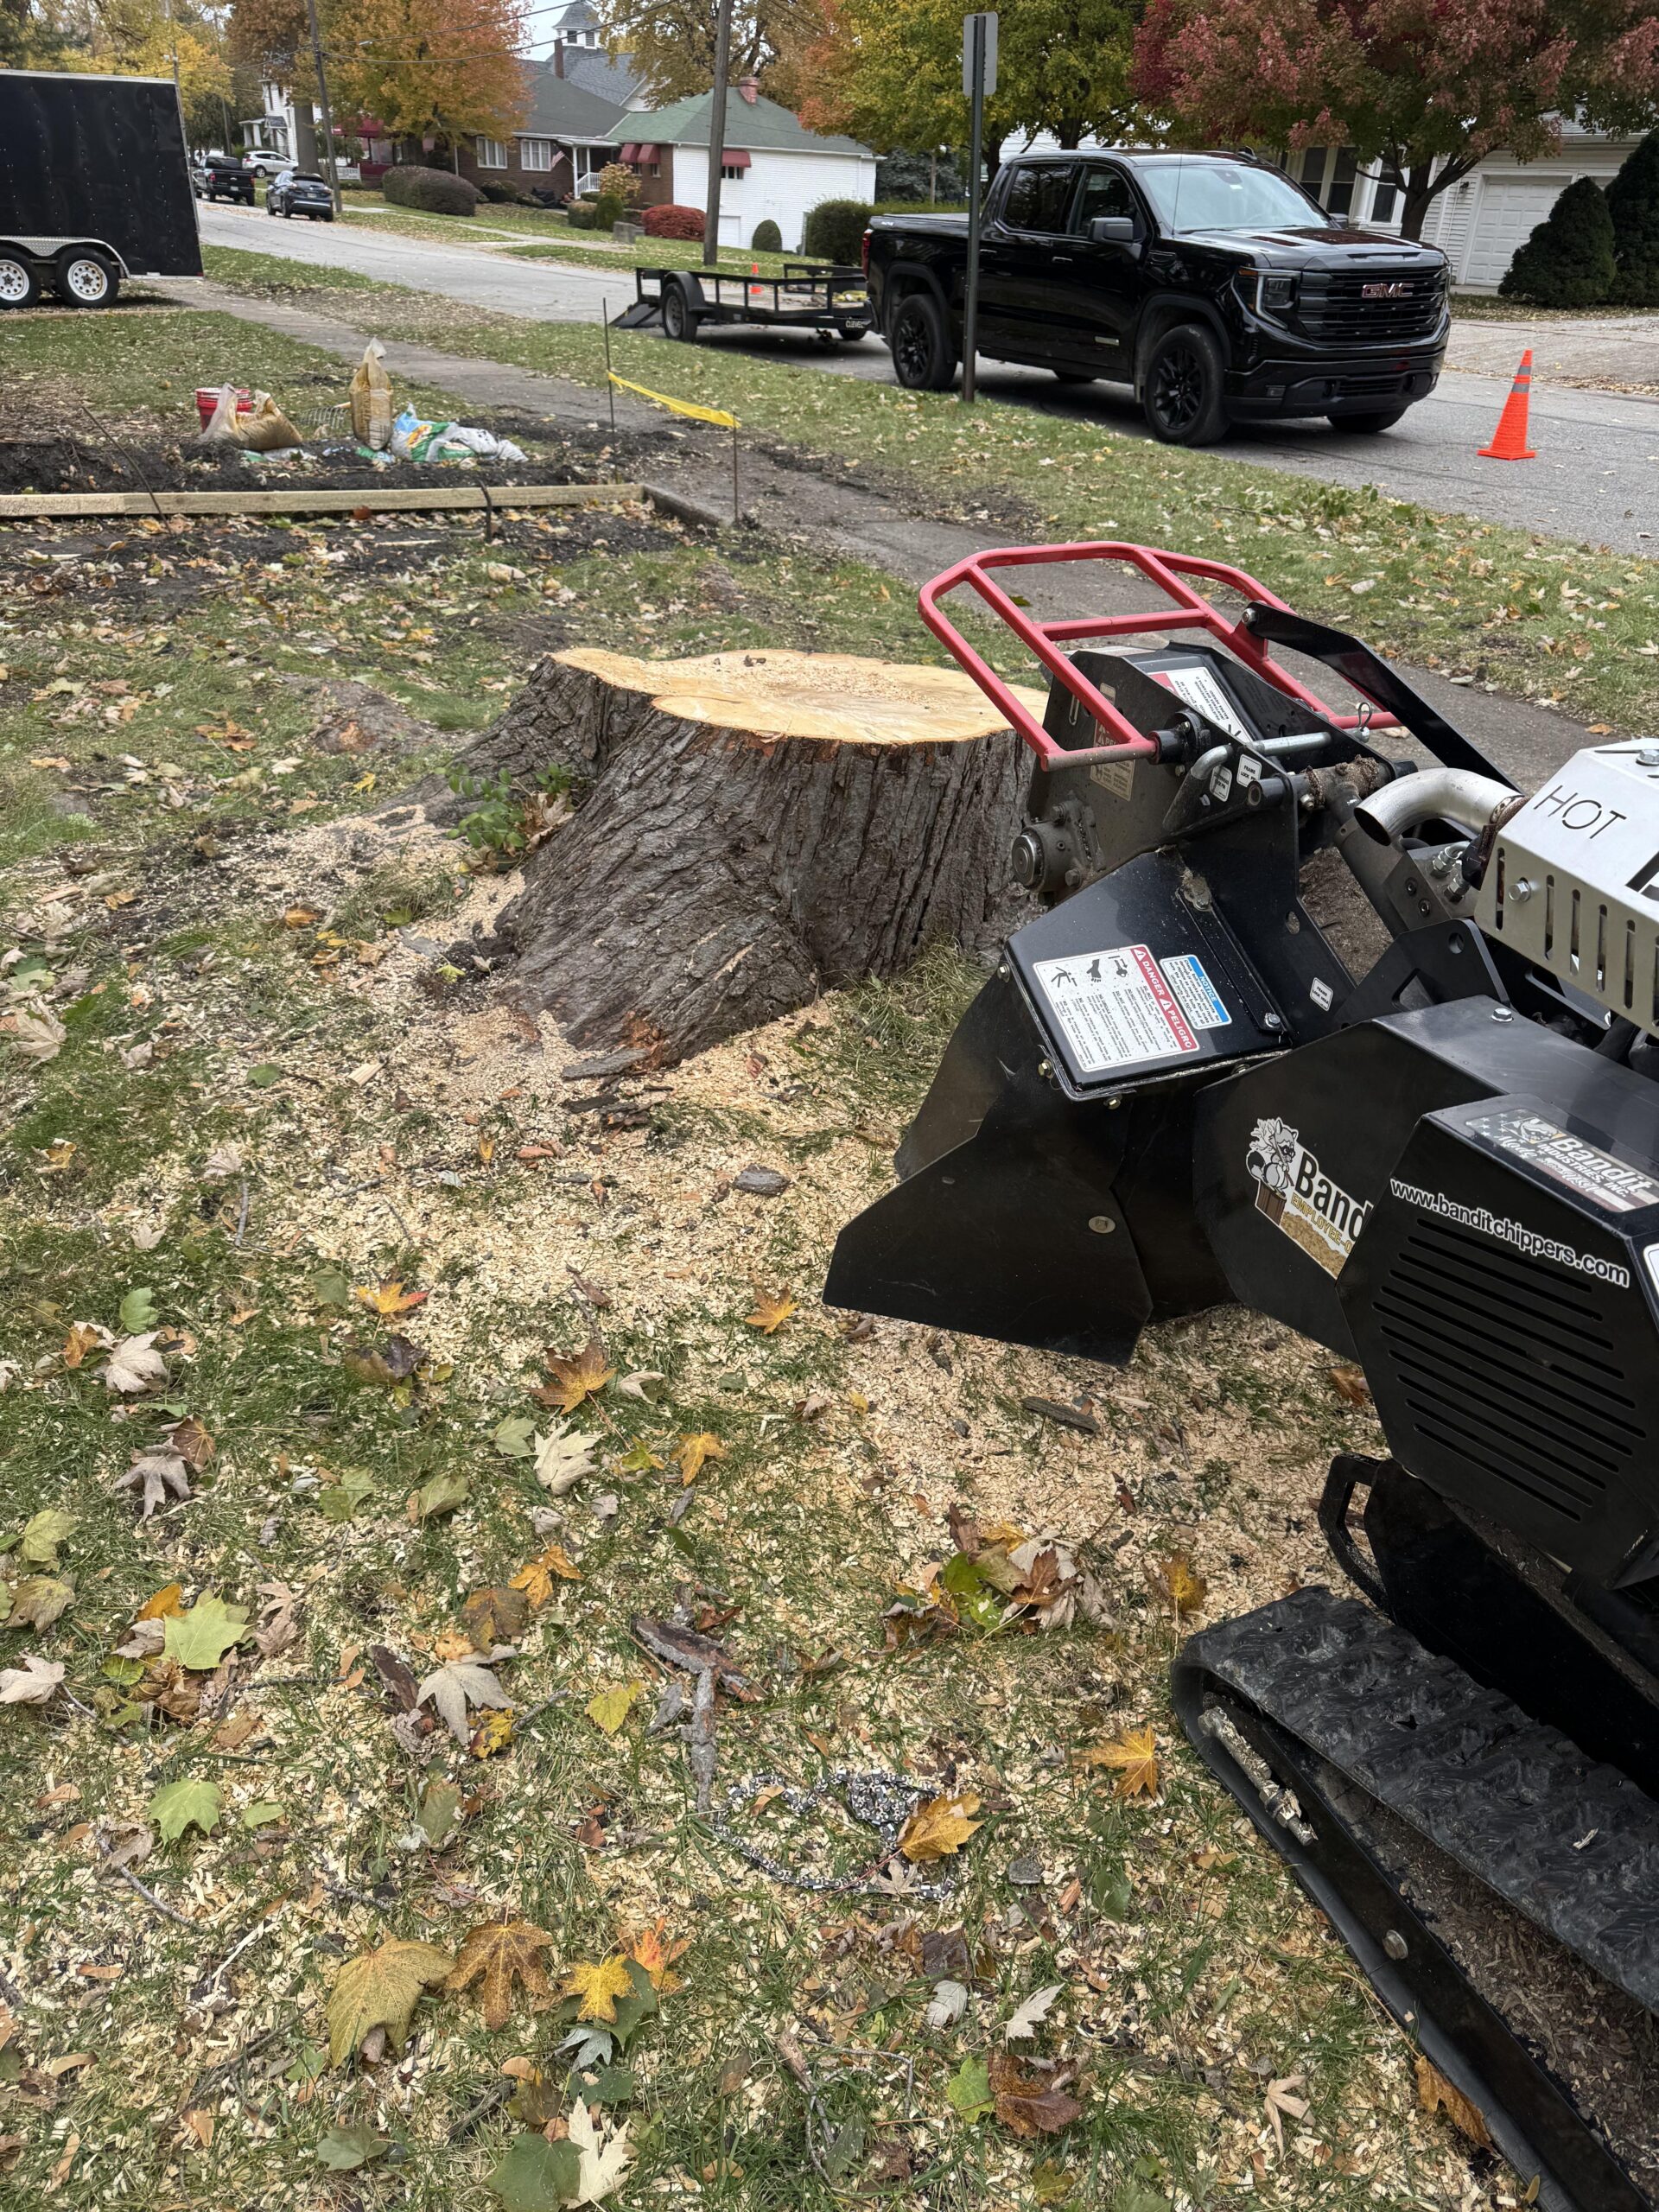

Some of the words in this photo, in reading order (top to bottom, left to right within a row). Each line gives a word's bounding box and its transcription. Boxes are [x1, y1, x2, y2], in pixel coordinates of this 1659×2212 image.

[1363, 283, 1414, 298] GMC
[1534, 785, 1627, 839] HOT
[1141, 960, 1166, 995] DANGER
[1199, 976, 1217, 1001] NOTICE
[1166, 1009, 1192, 1048] PELIGRO
[1536, 1143, 1604, 1185] INDUSTRIES,
[1603, 1181, 1628, 1198] INC.
[1549, 1138, 1653, 1192] Bandit
[1390, 1179, 1630, 1288] www.banditchippers.com
